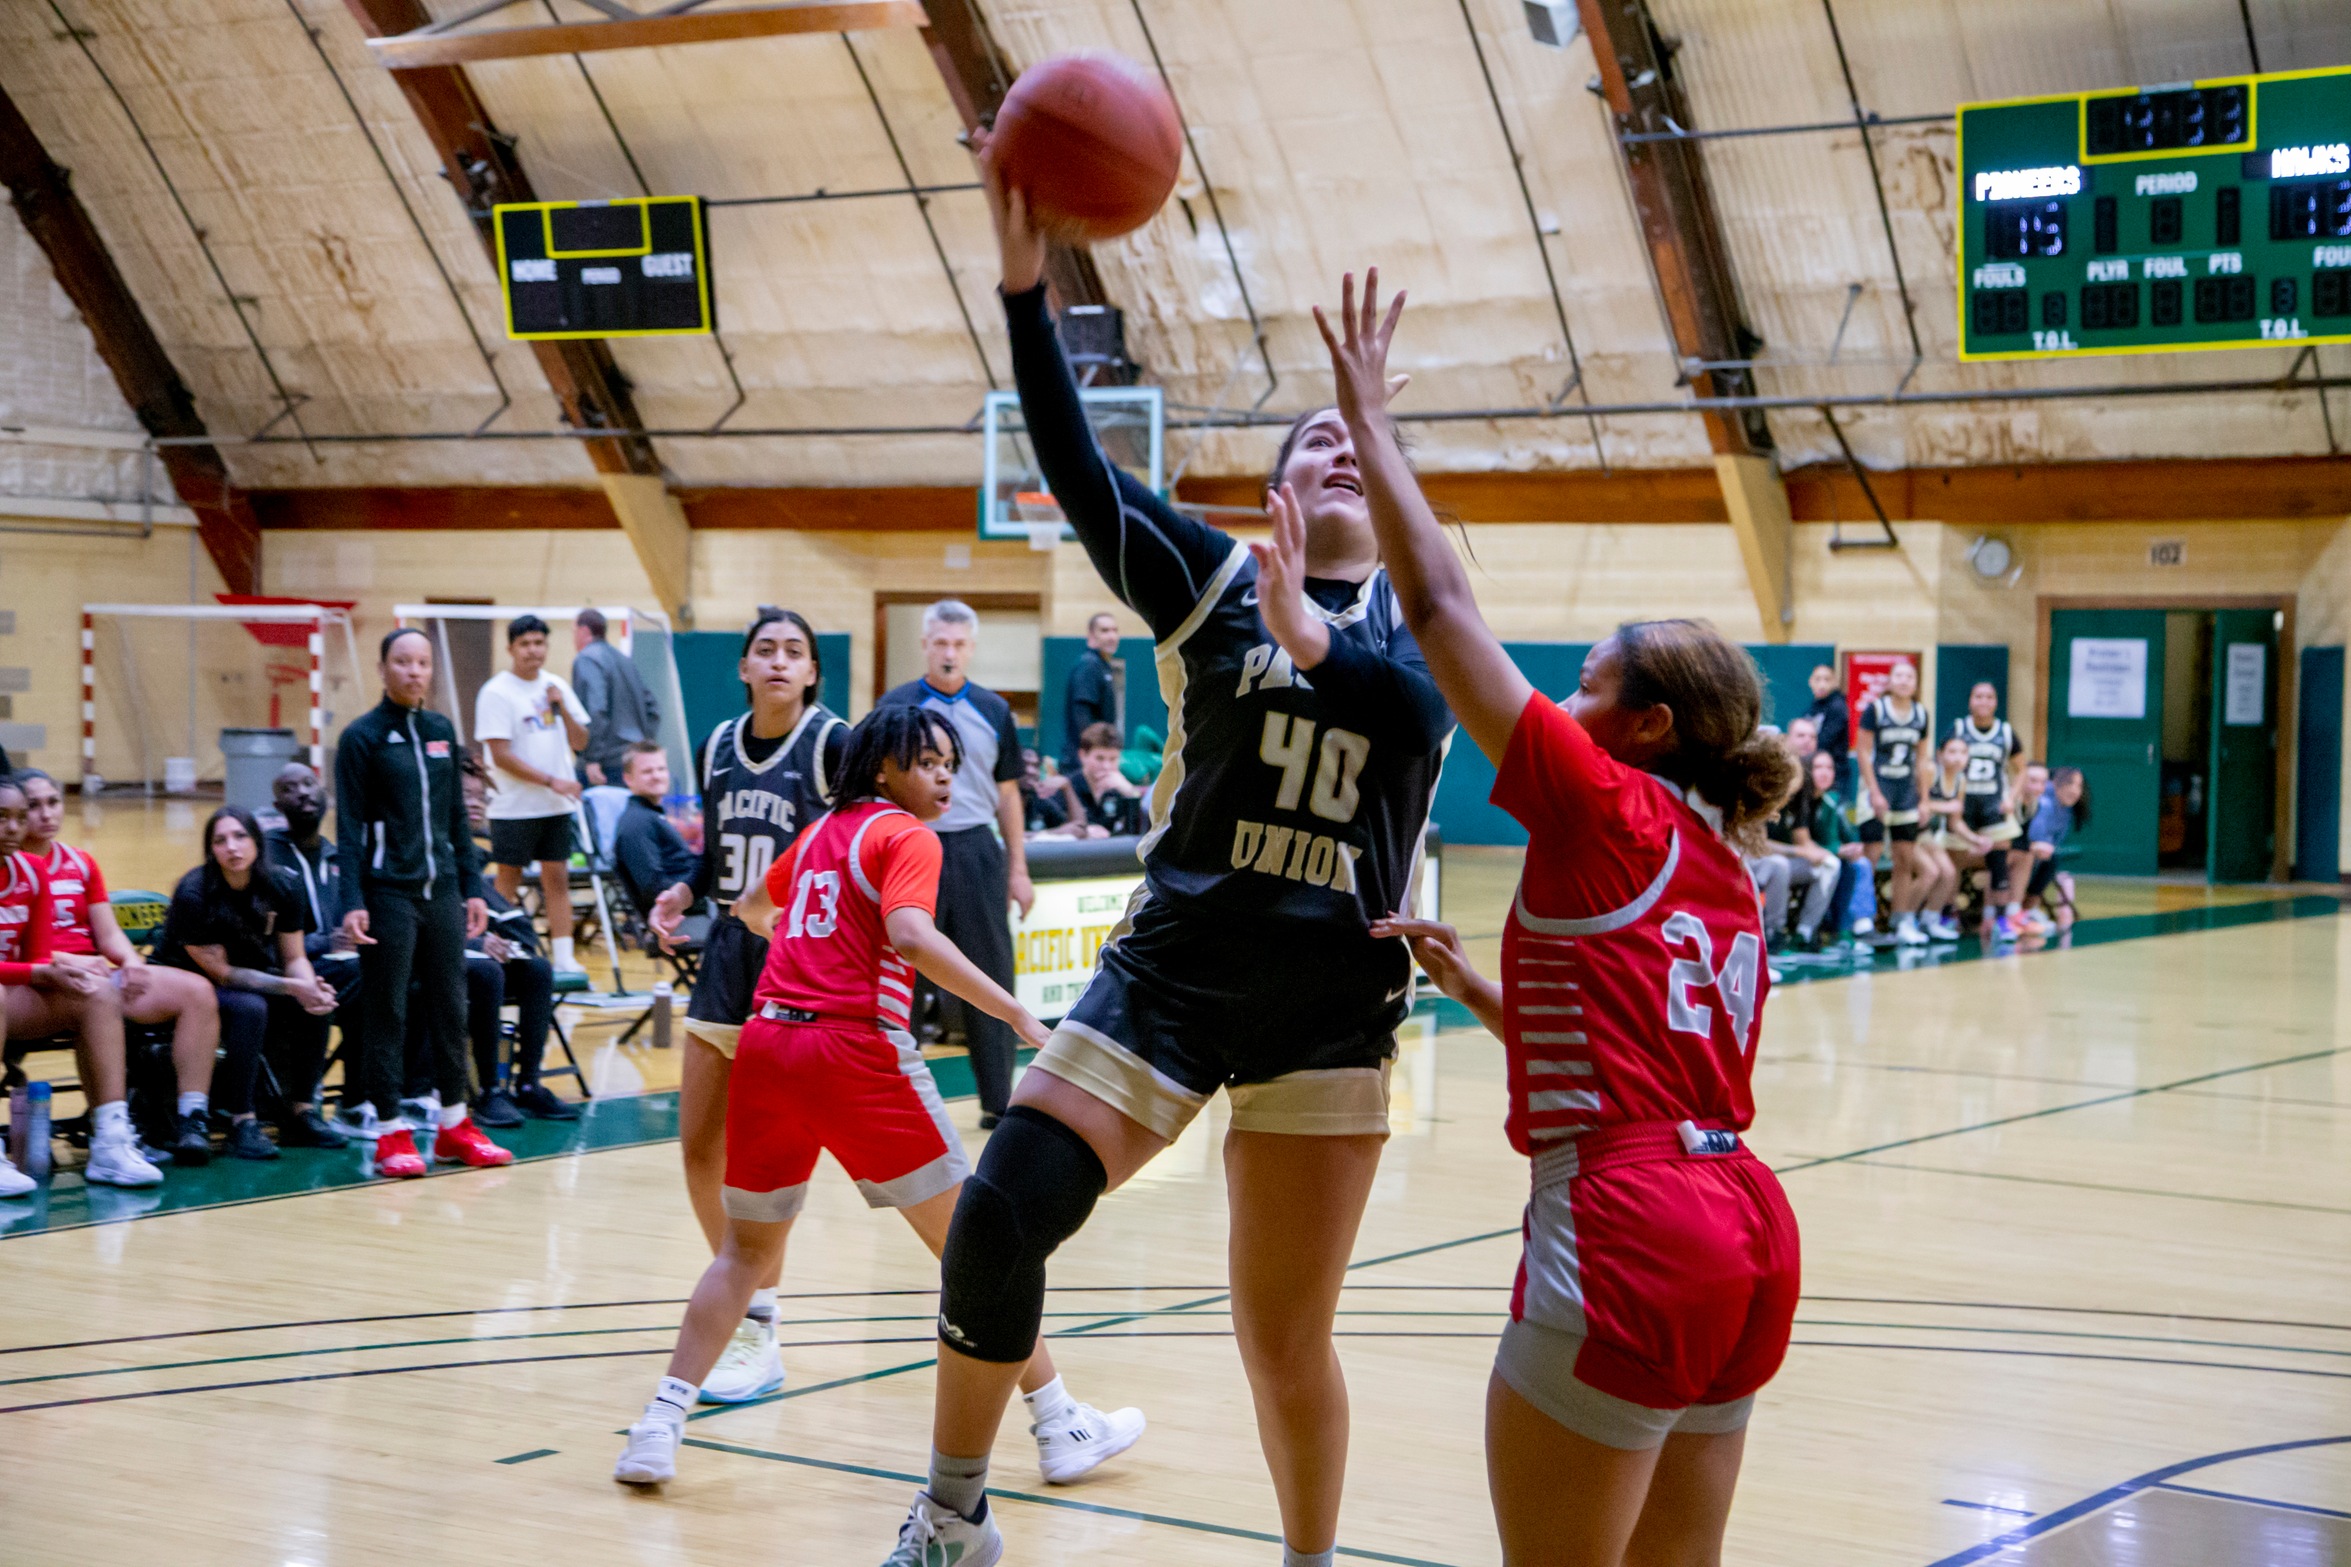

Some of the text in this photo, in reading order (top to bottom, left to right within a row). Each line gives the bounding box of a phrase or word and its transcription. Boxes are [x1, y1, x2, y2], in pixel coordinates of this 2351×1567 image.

[2136, 171, 2198, 196] PERIOD
[2143, 256, 2188, 278] FOUL
[2208, 252, 2242, 275] PTS
[2313, 245, 2351, 268] FOU
[1974, 264, 2026, 288] FOULS
[2087, 259, 2129, 282] PLYR
[1259, 710, 1371, 824] 40
[718, 832, 776, 894] 30
[1230, 819, 1363, 895] UNION
[785, 869, 841, 939] 13
[1661, 911, 1760, 1057] 24
